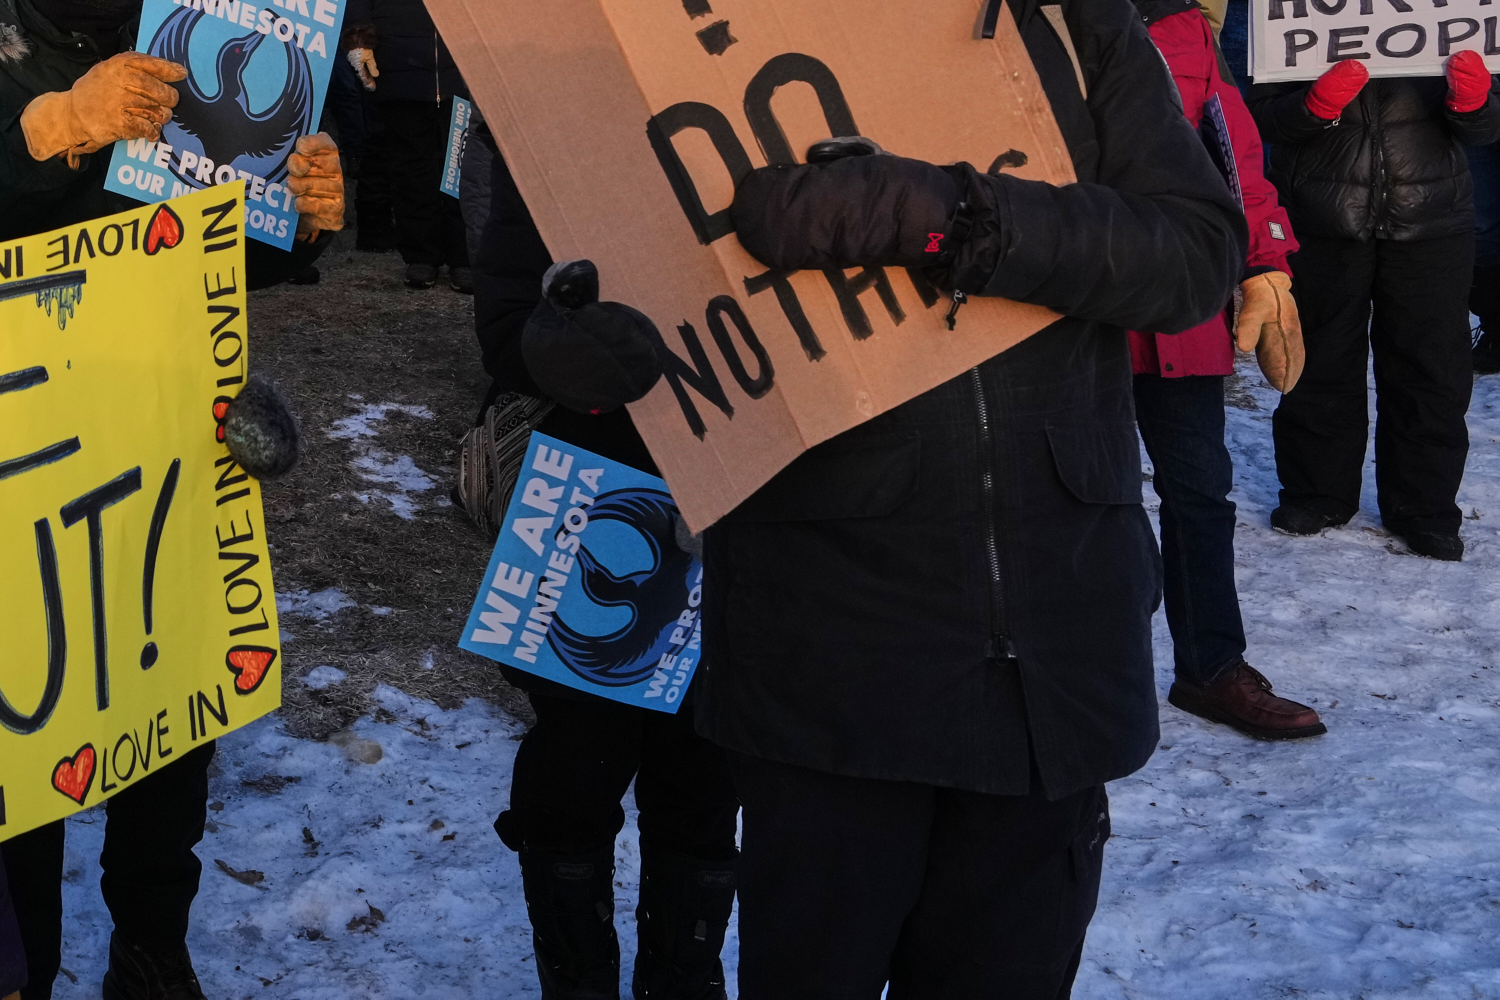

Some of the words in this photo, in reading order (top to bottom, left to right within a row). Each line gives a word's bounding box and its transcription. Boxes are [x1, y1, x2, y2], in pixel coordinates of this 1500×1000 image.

[1283, 16, 1500, 67] PEOPL
[117, 164, 166, 197] OUR
[126, 138, 173, 169] WE
[46, 222, 140, 272] LOVE
[202, 197, 238, 254] IN
[204, 265, 244, 387] LOVE
[470, 562, 535, 645] WE
[511, 443, 574, 557] ARE
[513, 467, 605, 664] MINNESOTA
[215, 509, 269, 637] LOVE
[643, 652, 679, 699] WE
[665, 656, 694, 704] OUR
[101, 708, 173, 794] LOVE
[188, 684, 229, 741] IN
